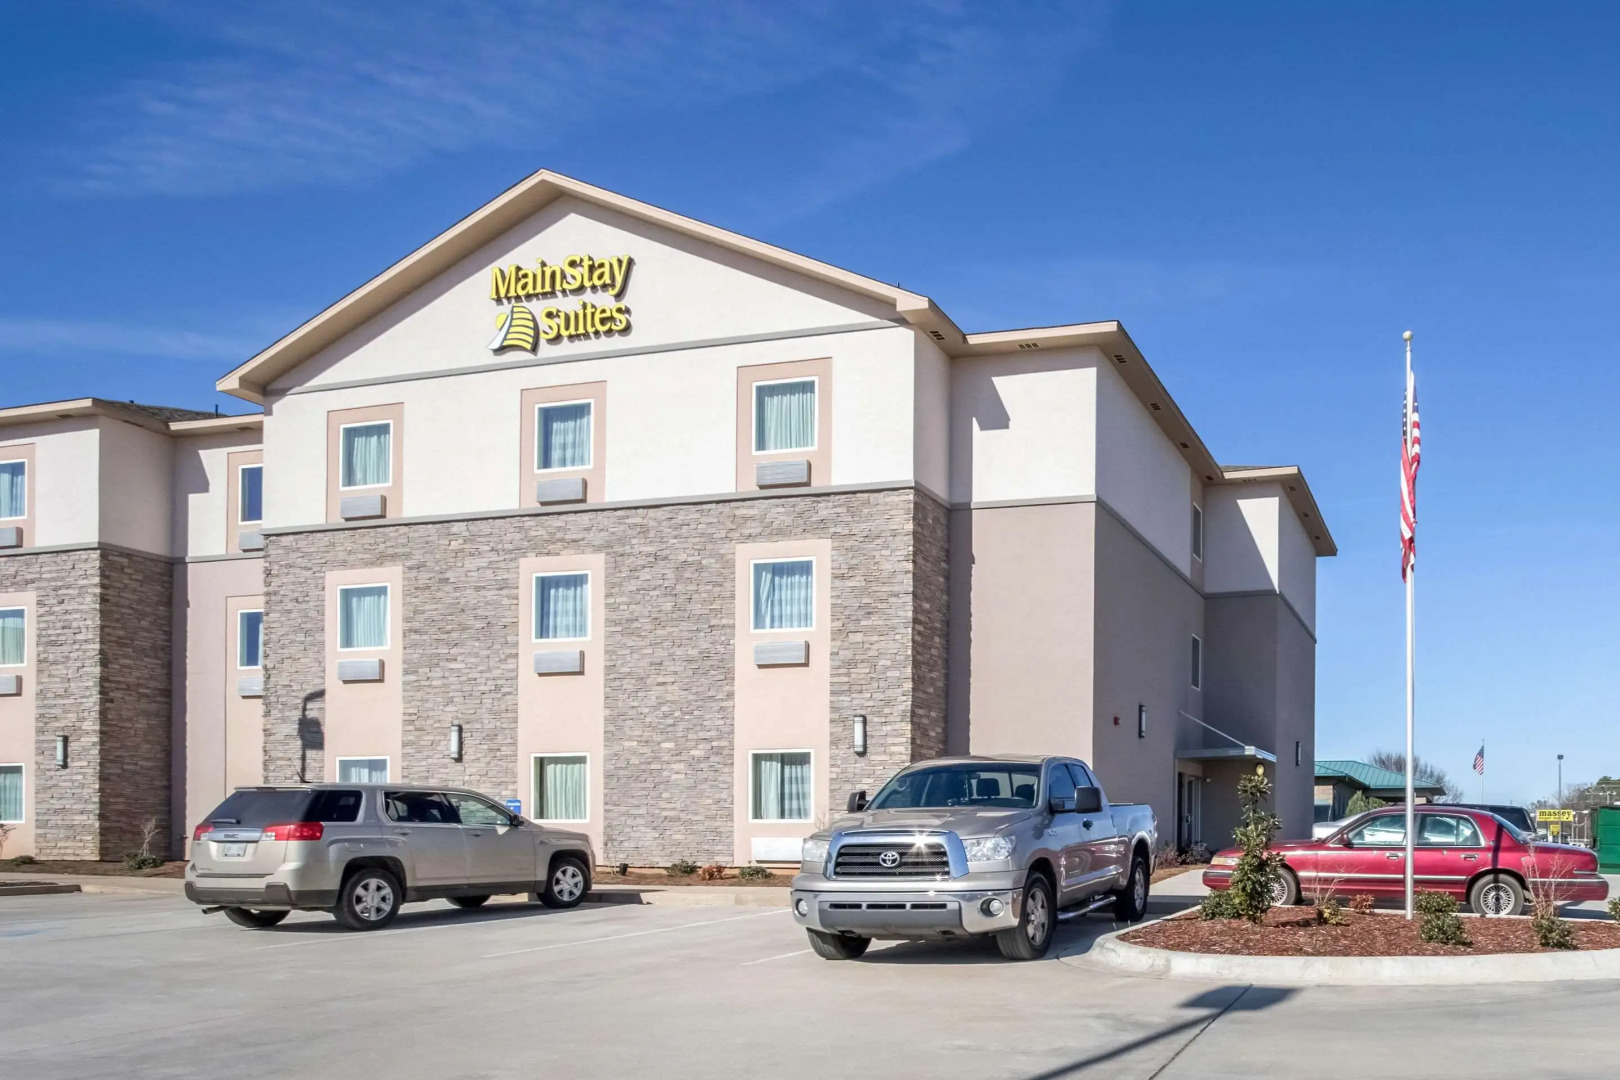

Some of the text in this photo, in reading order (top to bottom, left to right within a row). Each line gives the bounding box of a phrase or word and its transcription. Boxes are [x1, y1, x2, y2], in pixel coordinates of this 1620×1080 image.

[490, 253, 632, 298] MainStay
[539, 299, 629, 340] Suites
[1538, 810, 1572, 820] massey
